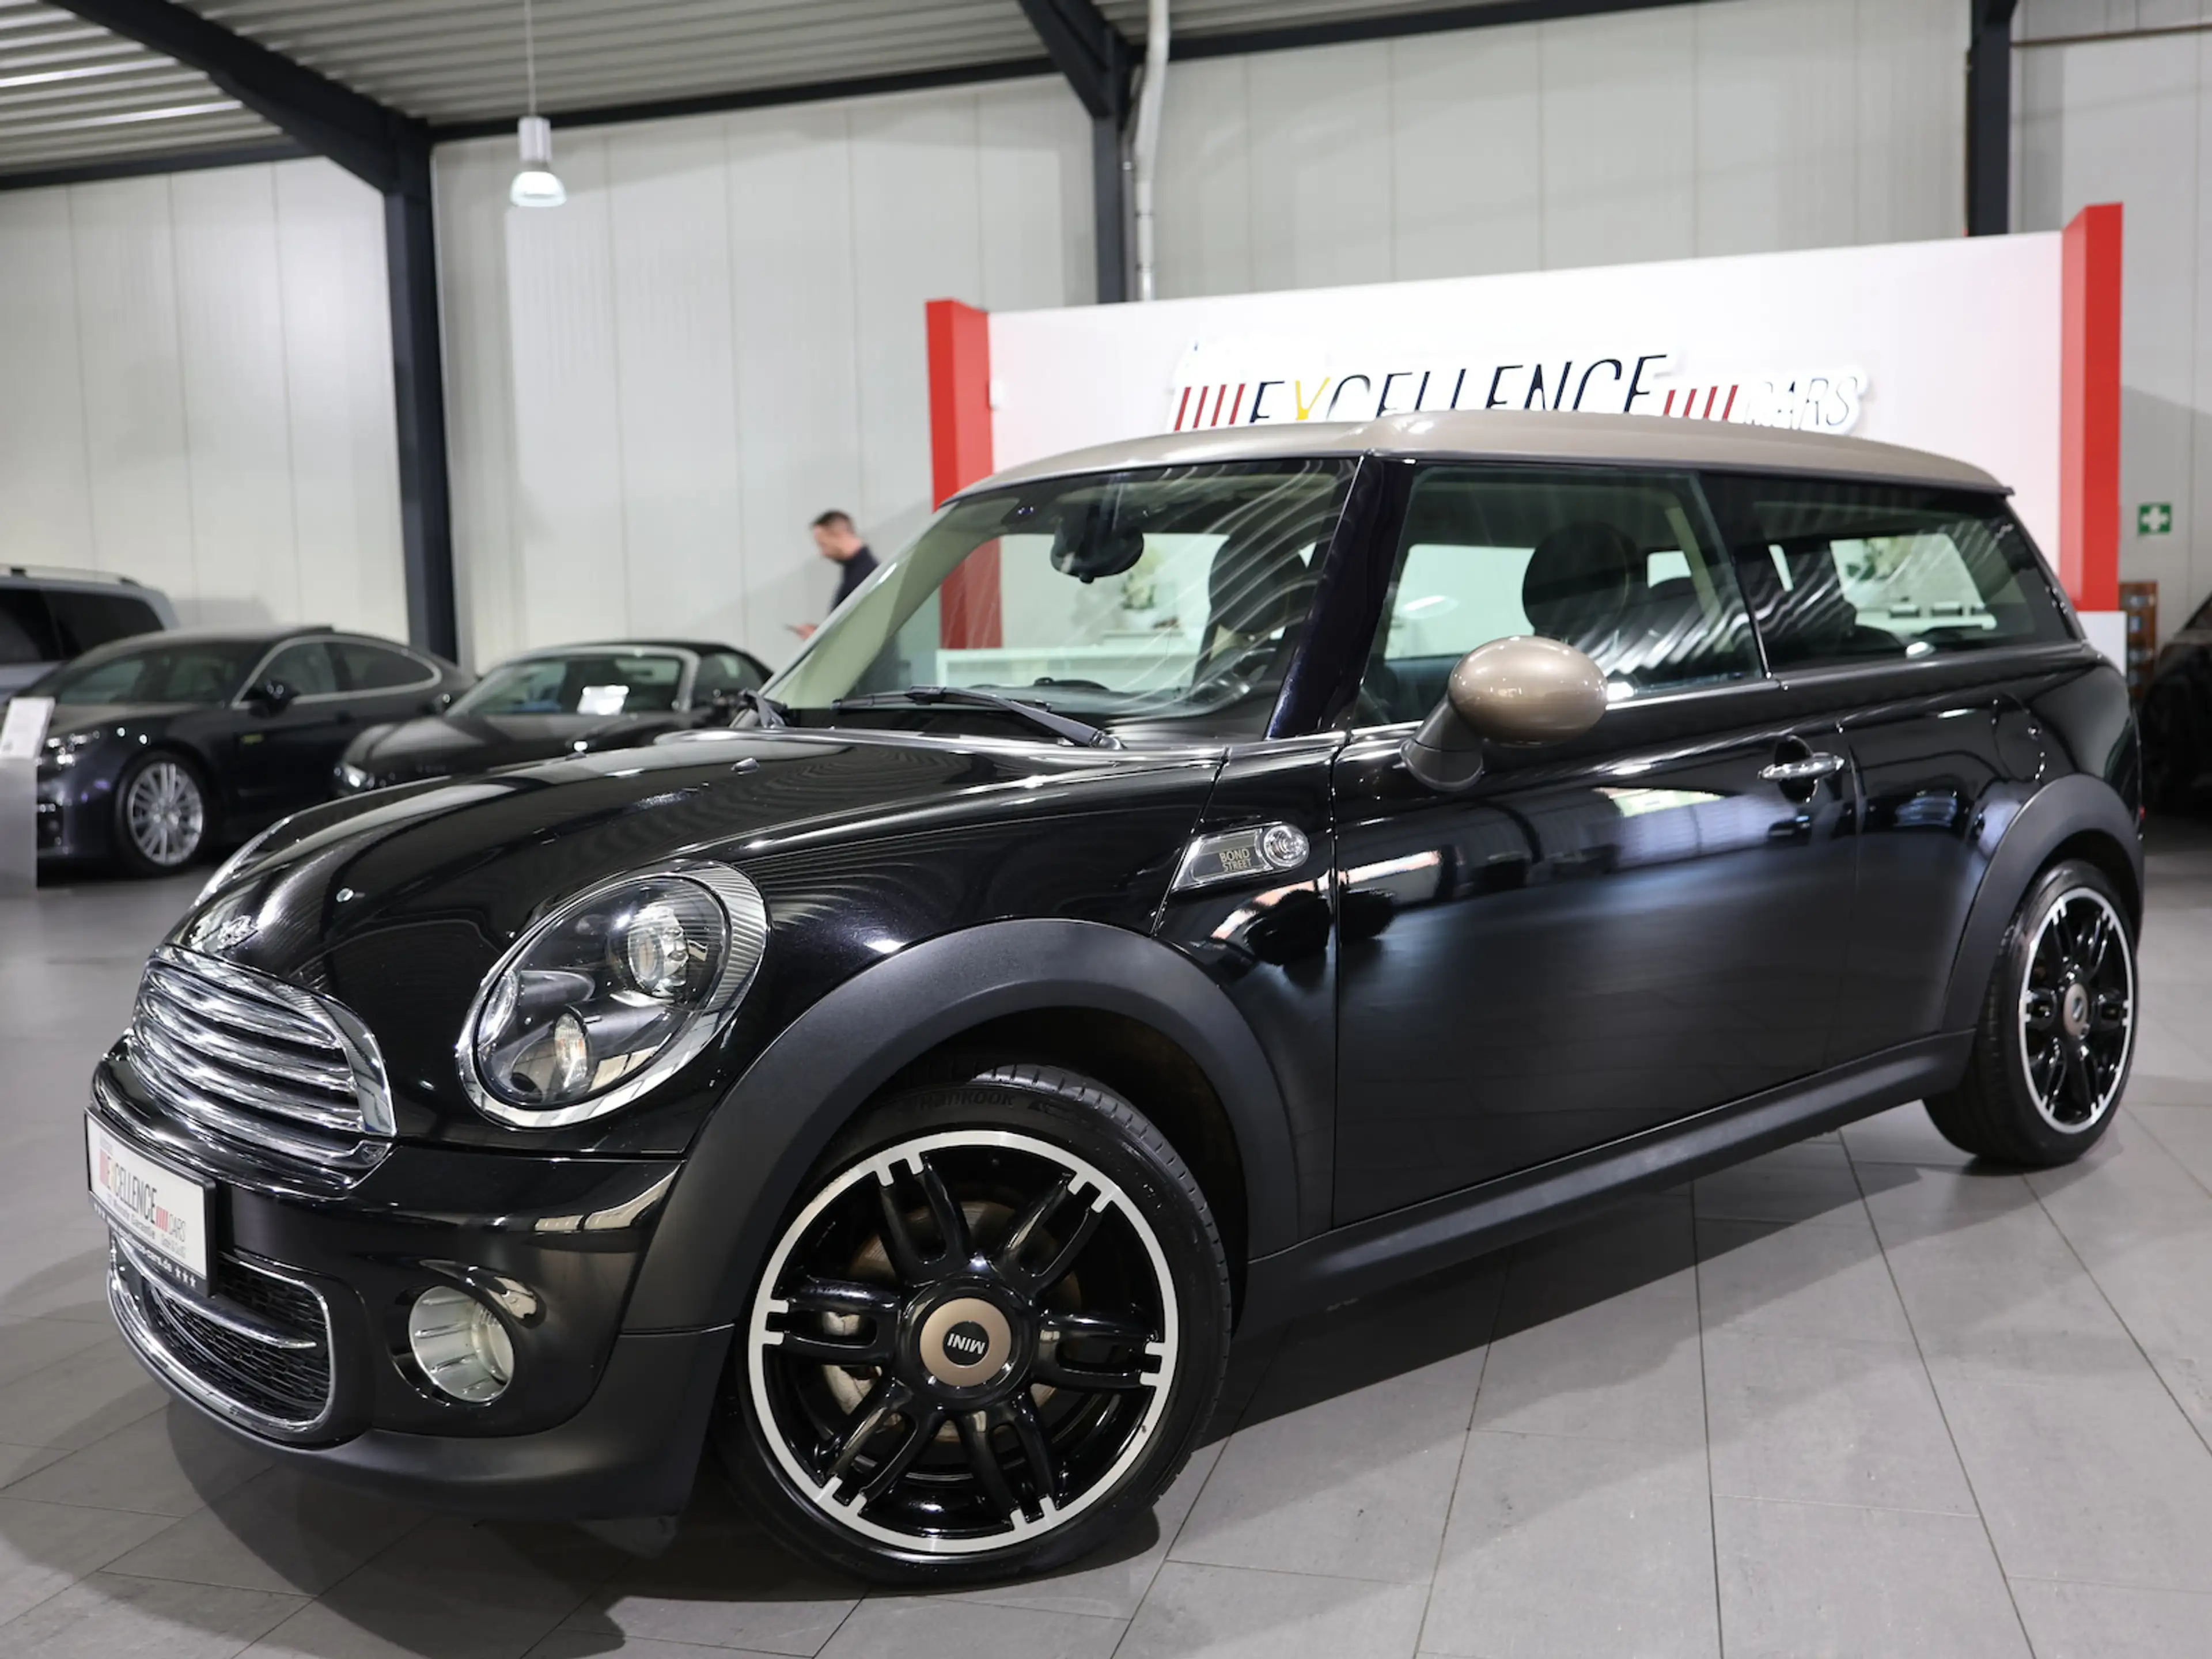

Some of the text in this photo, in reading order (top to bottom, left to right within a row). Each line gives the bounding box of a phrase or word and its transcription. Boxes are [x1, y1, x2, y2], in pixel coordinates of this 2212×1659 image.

[1219, 848, 1251, 863] BOND
[1222, 859, 1252, 872] STREET
[169, 1213, 186, 1243] CARS
[948, 1334, 986, 1354] MINI
